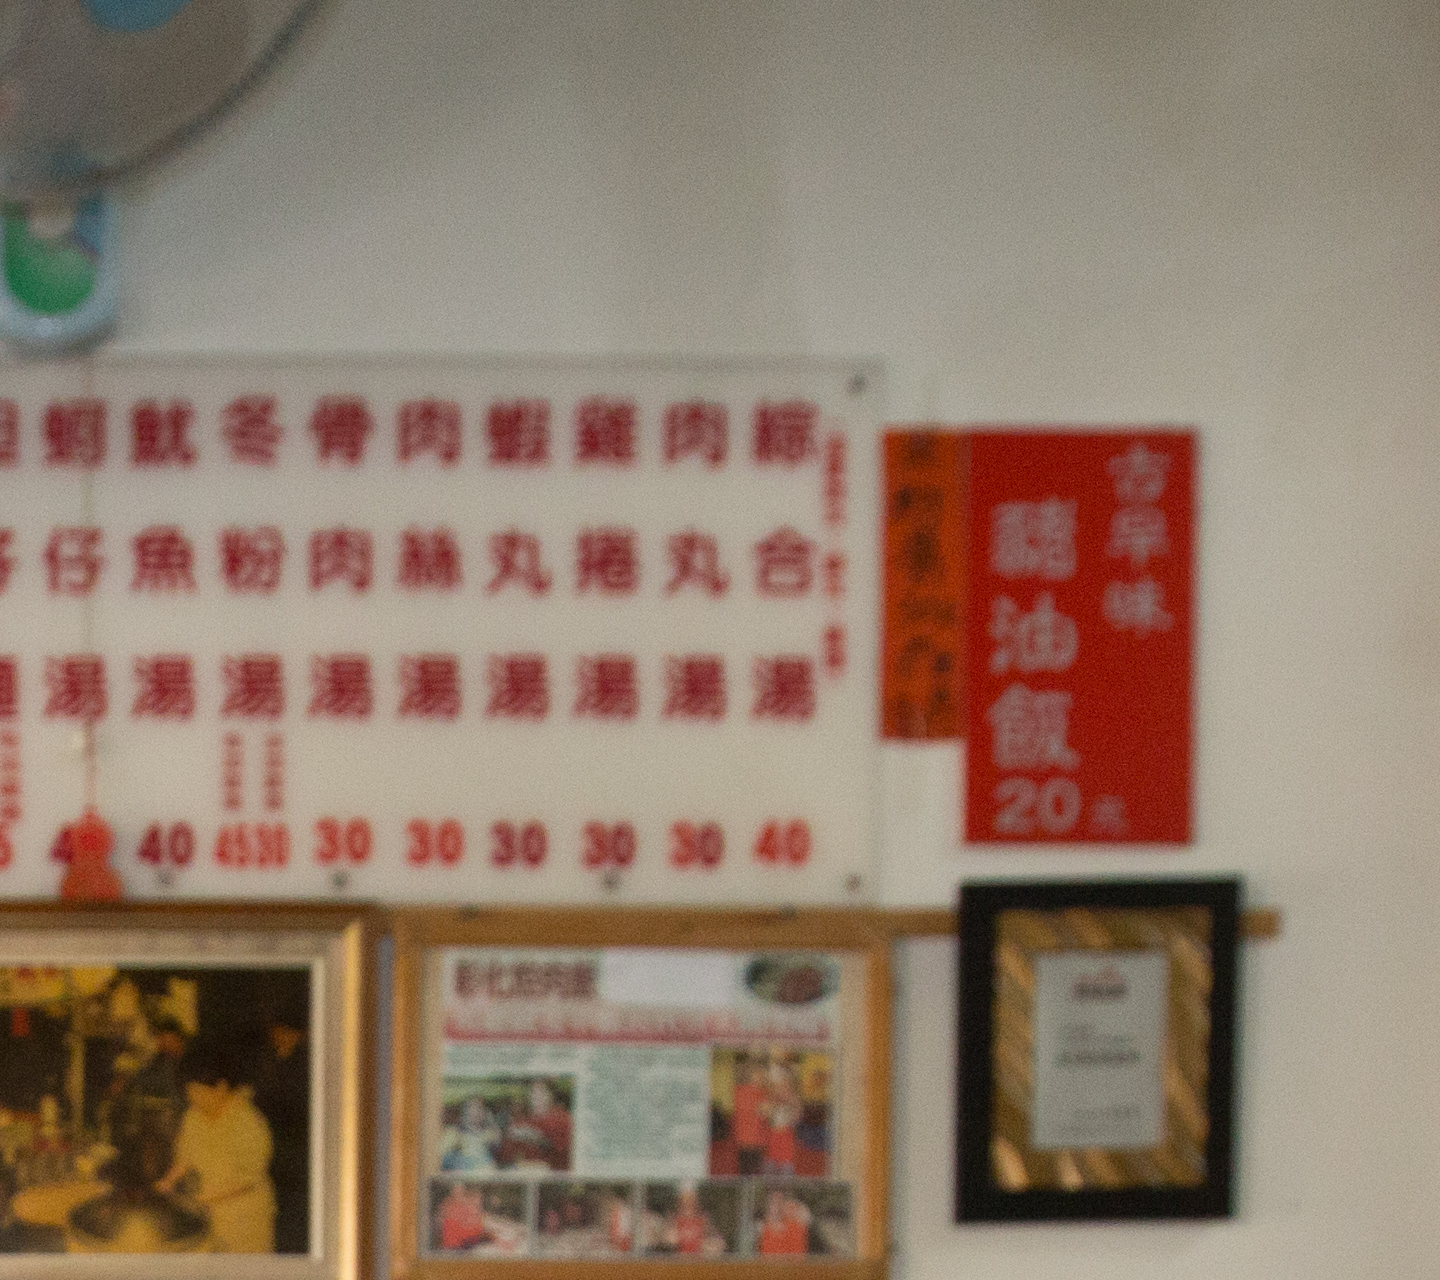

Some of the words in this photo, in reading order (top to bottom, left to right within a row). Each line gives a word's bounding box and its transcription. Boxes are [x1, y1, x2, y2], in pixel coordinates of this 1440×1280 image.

[130, 402, 198, 722] 魷魚湯
[217, 398, 287, 722] 冬粉湯
[662, 402, 729, 722] 肉丸湯
[750, 402, 818, 722] 綜合湯
[1105, 441, 1174, 638] 古早味
[136, 820, 197, 871] 40
[312, 815, 375, 868] 30
[404, 817, 467, 871] 30
[490, 819, 550, 871] 30
[667, 819, 725, 872] 30
[751, 817, 814, 869] 40
